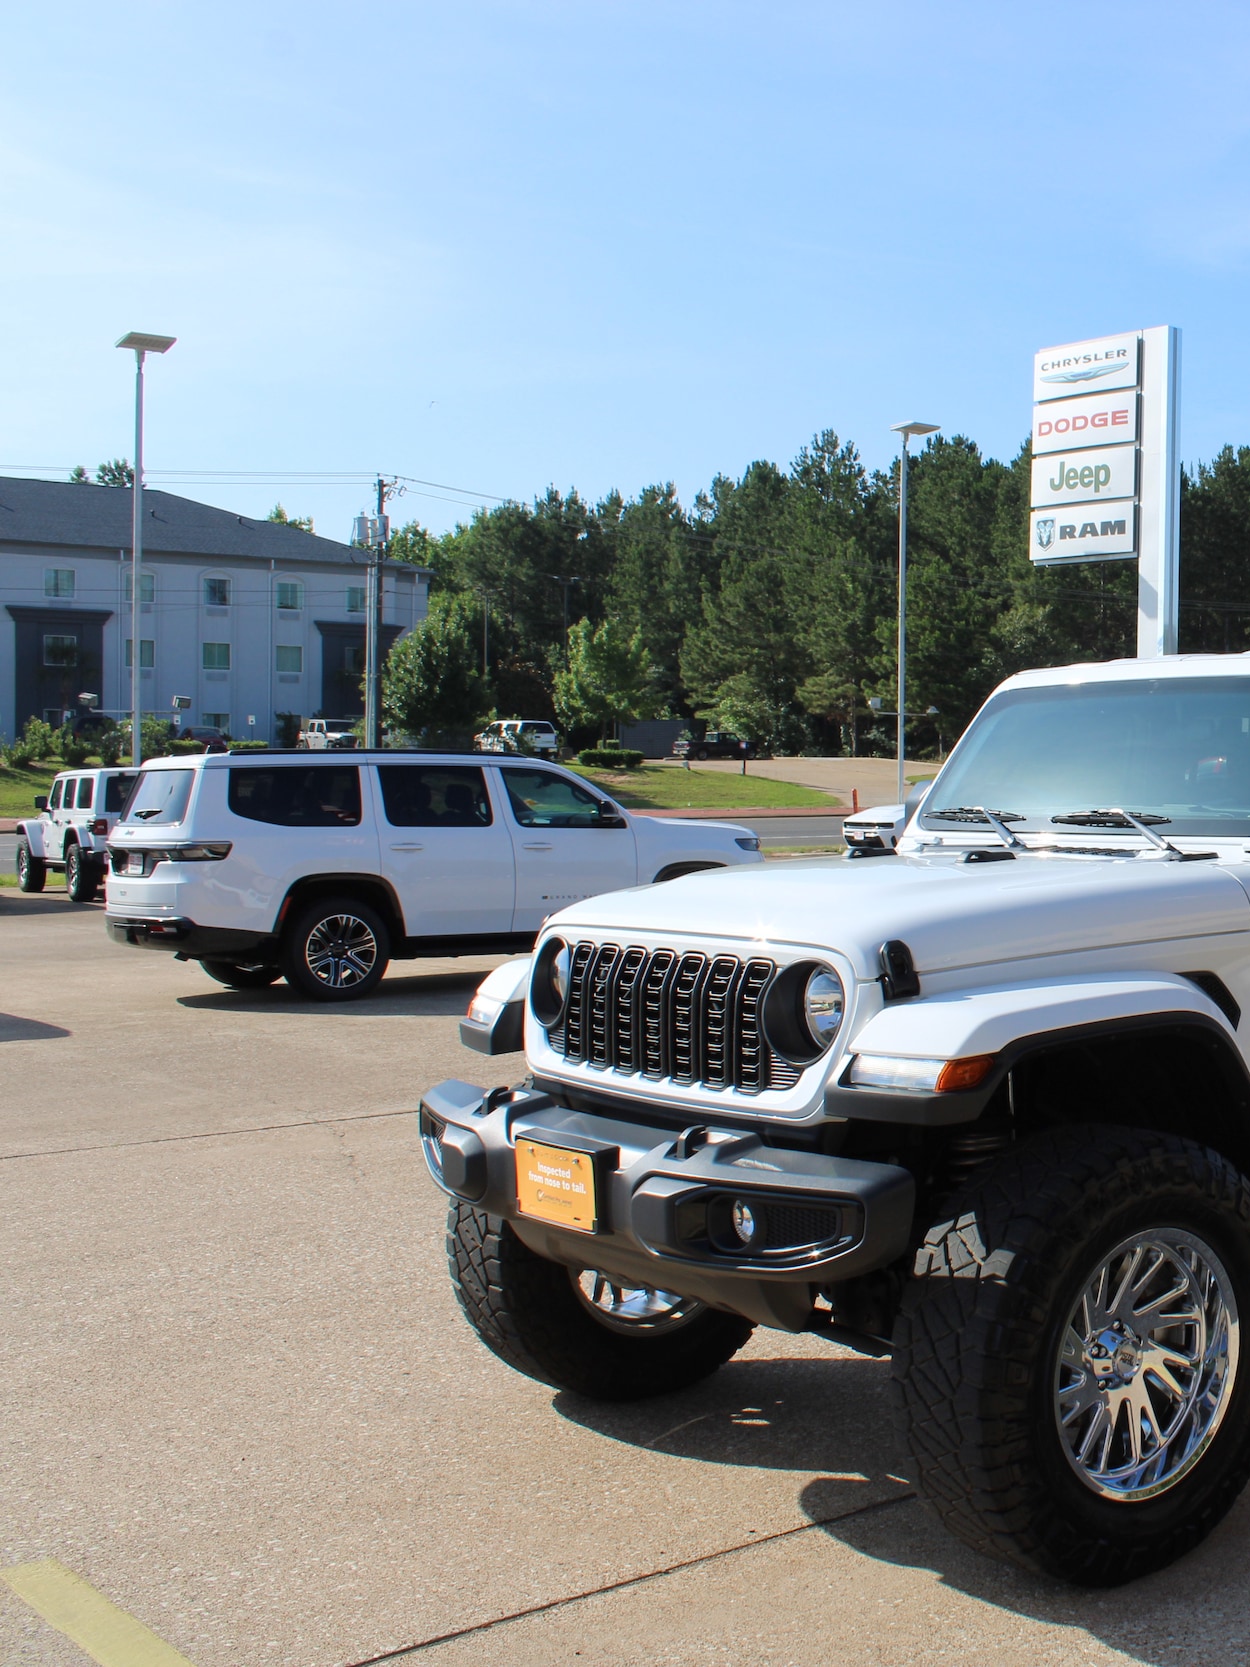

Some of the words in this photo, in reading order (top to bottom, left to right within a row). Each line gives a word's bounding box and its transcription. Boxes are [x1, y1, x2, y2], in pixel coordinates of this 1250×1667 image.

[1040, 348, 1128, 372] CHRYSLER
[1038, 409, 1129, 437] DODGE
[1049, 461, 1111, 493] Jeep
[1059, 519, 1126, 540] RAM
[537, 1162, 571, 1179] Inspected
[528, 1171, 544, 1184] from
[544, 1176, 561, 1189] nose
[562, 1180, 570, 1191] to
[571, 1182, 586, 1194] tail.
